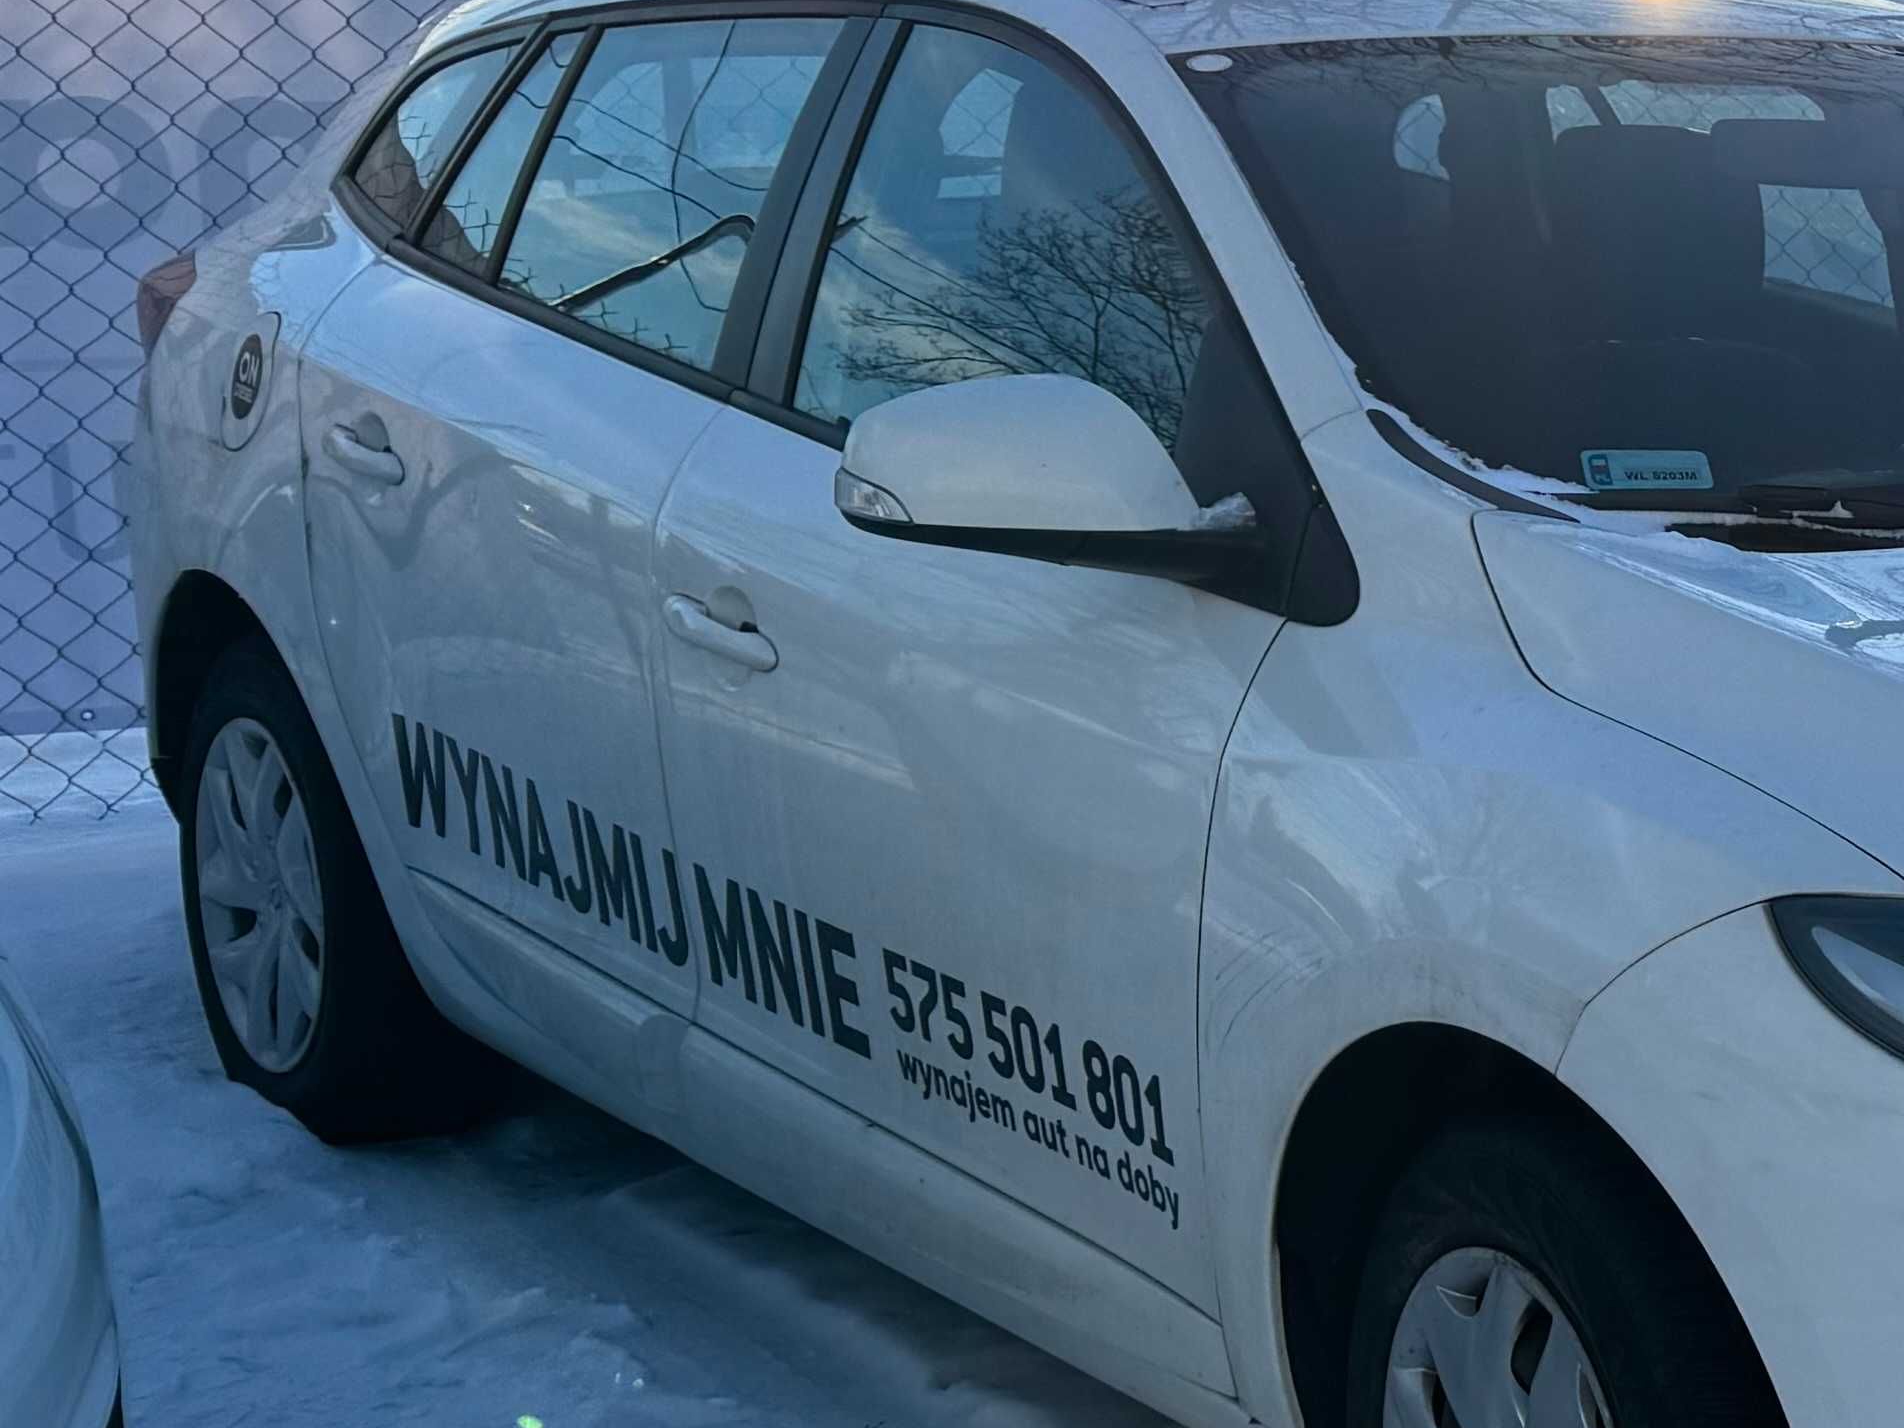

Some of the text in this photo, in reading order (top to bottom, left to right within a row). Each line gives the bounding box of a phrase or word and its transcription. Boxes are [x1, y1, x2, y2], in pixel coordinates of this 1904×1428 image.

[240, 351, 260, 387] ON
[391, 712, 872, 1060] WYNAJMIJ MNIE
[882, 947, 1175, 1167] 575 501 801
[896, 1049, 1179, 1230] wynajem aut na doby
